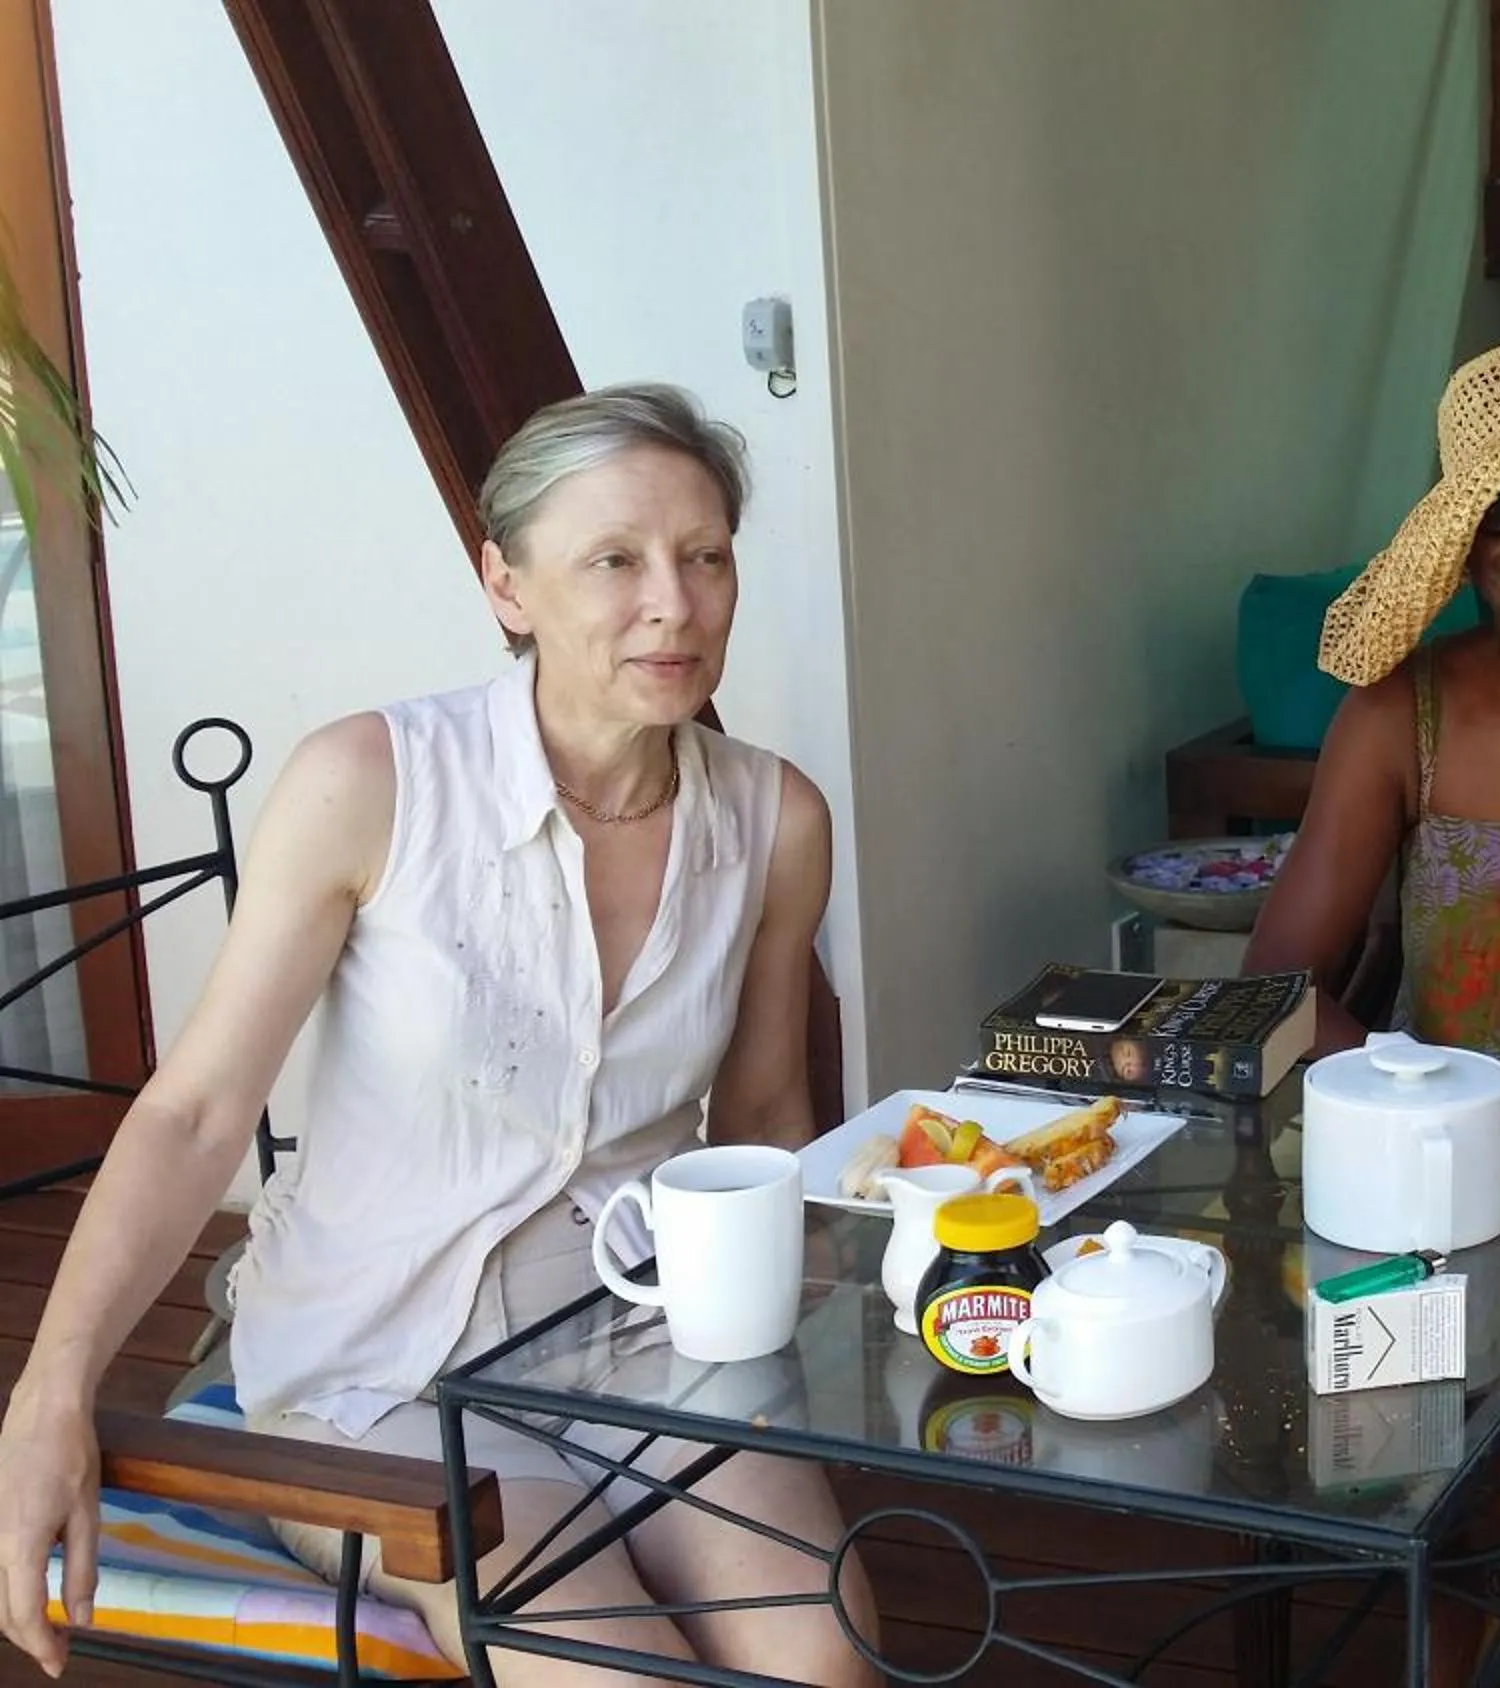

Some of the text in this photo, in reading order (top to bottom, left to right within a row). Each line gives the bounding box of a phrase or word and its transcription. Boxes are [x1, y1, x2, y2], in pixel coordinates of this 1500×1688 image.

[994, 1032, 1088, 1057] PHILIPPA
[985, 1051, 1096, 1077] GREGORY
[942, 1294, 1029, 1324] MARMITE
[1333, 1313, 1363, 1389] Marlboro
